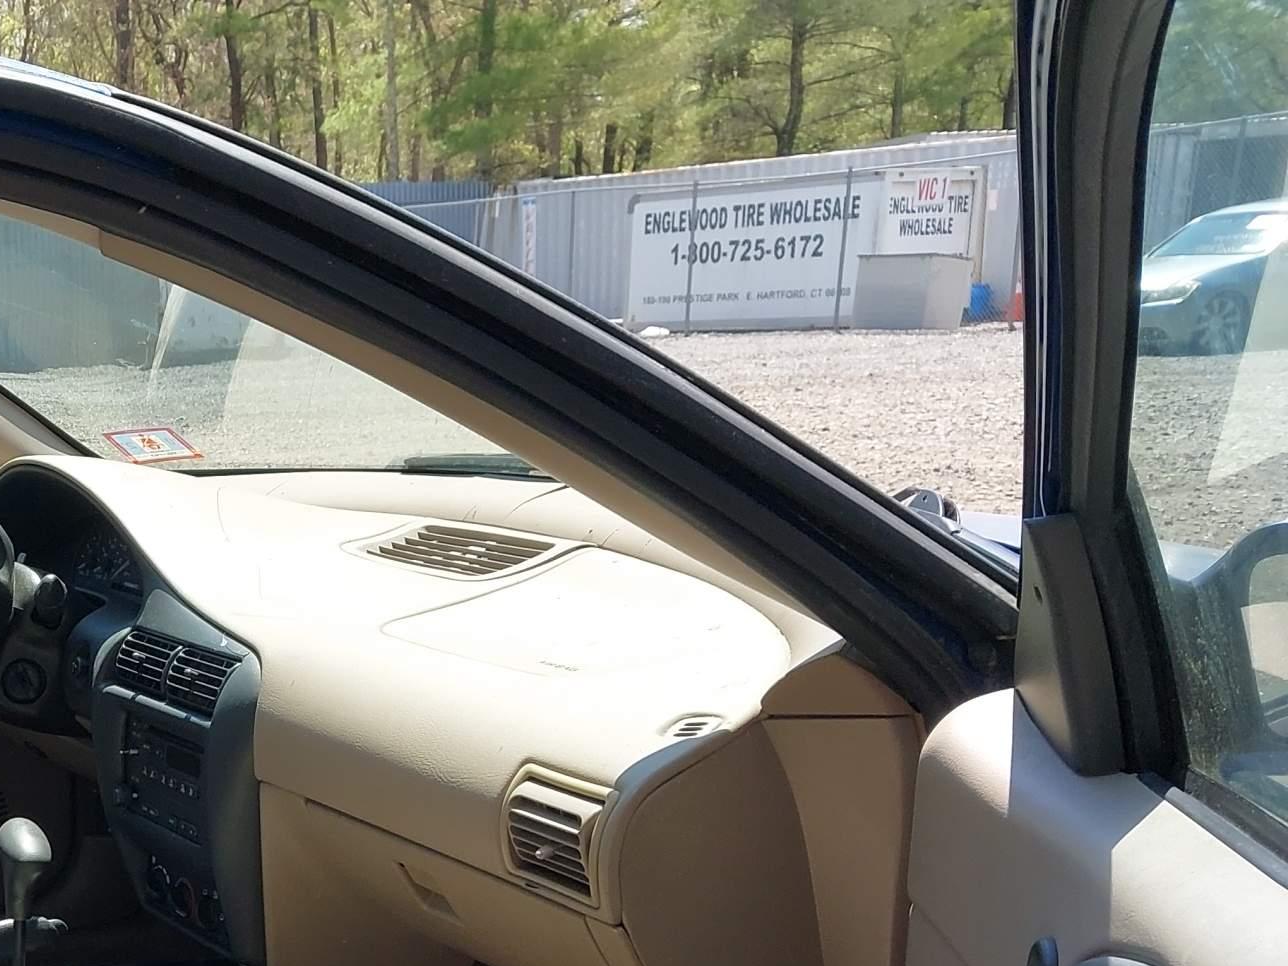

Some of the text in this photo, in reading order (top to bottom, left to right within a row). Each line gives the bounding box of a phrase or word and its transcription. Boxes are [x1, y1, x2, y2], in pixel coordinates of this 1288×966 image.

[918, 177, 938, 200] VIC
[948, 195, 969, 213] TIRE
[644, 195, 861, 235] ENGLEWOOD TIRE WHOLESALE
[899, 218, 954, 237] WHOLESALE
[671, 234, 824, 265] 1-800-725-6172
[716, 293, 740, 301] PARK
[810, 288, 822, 298] CT
